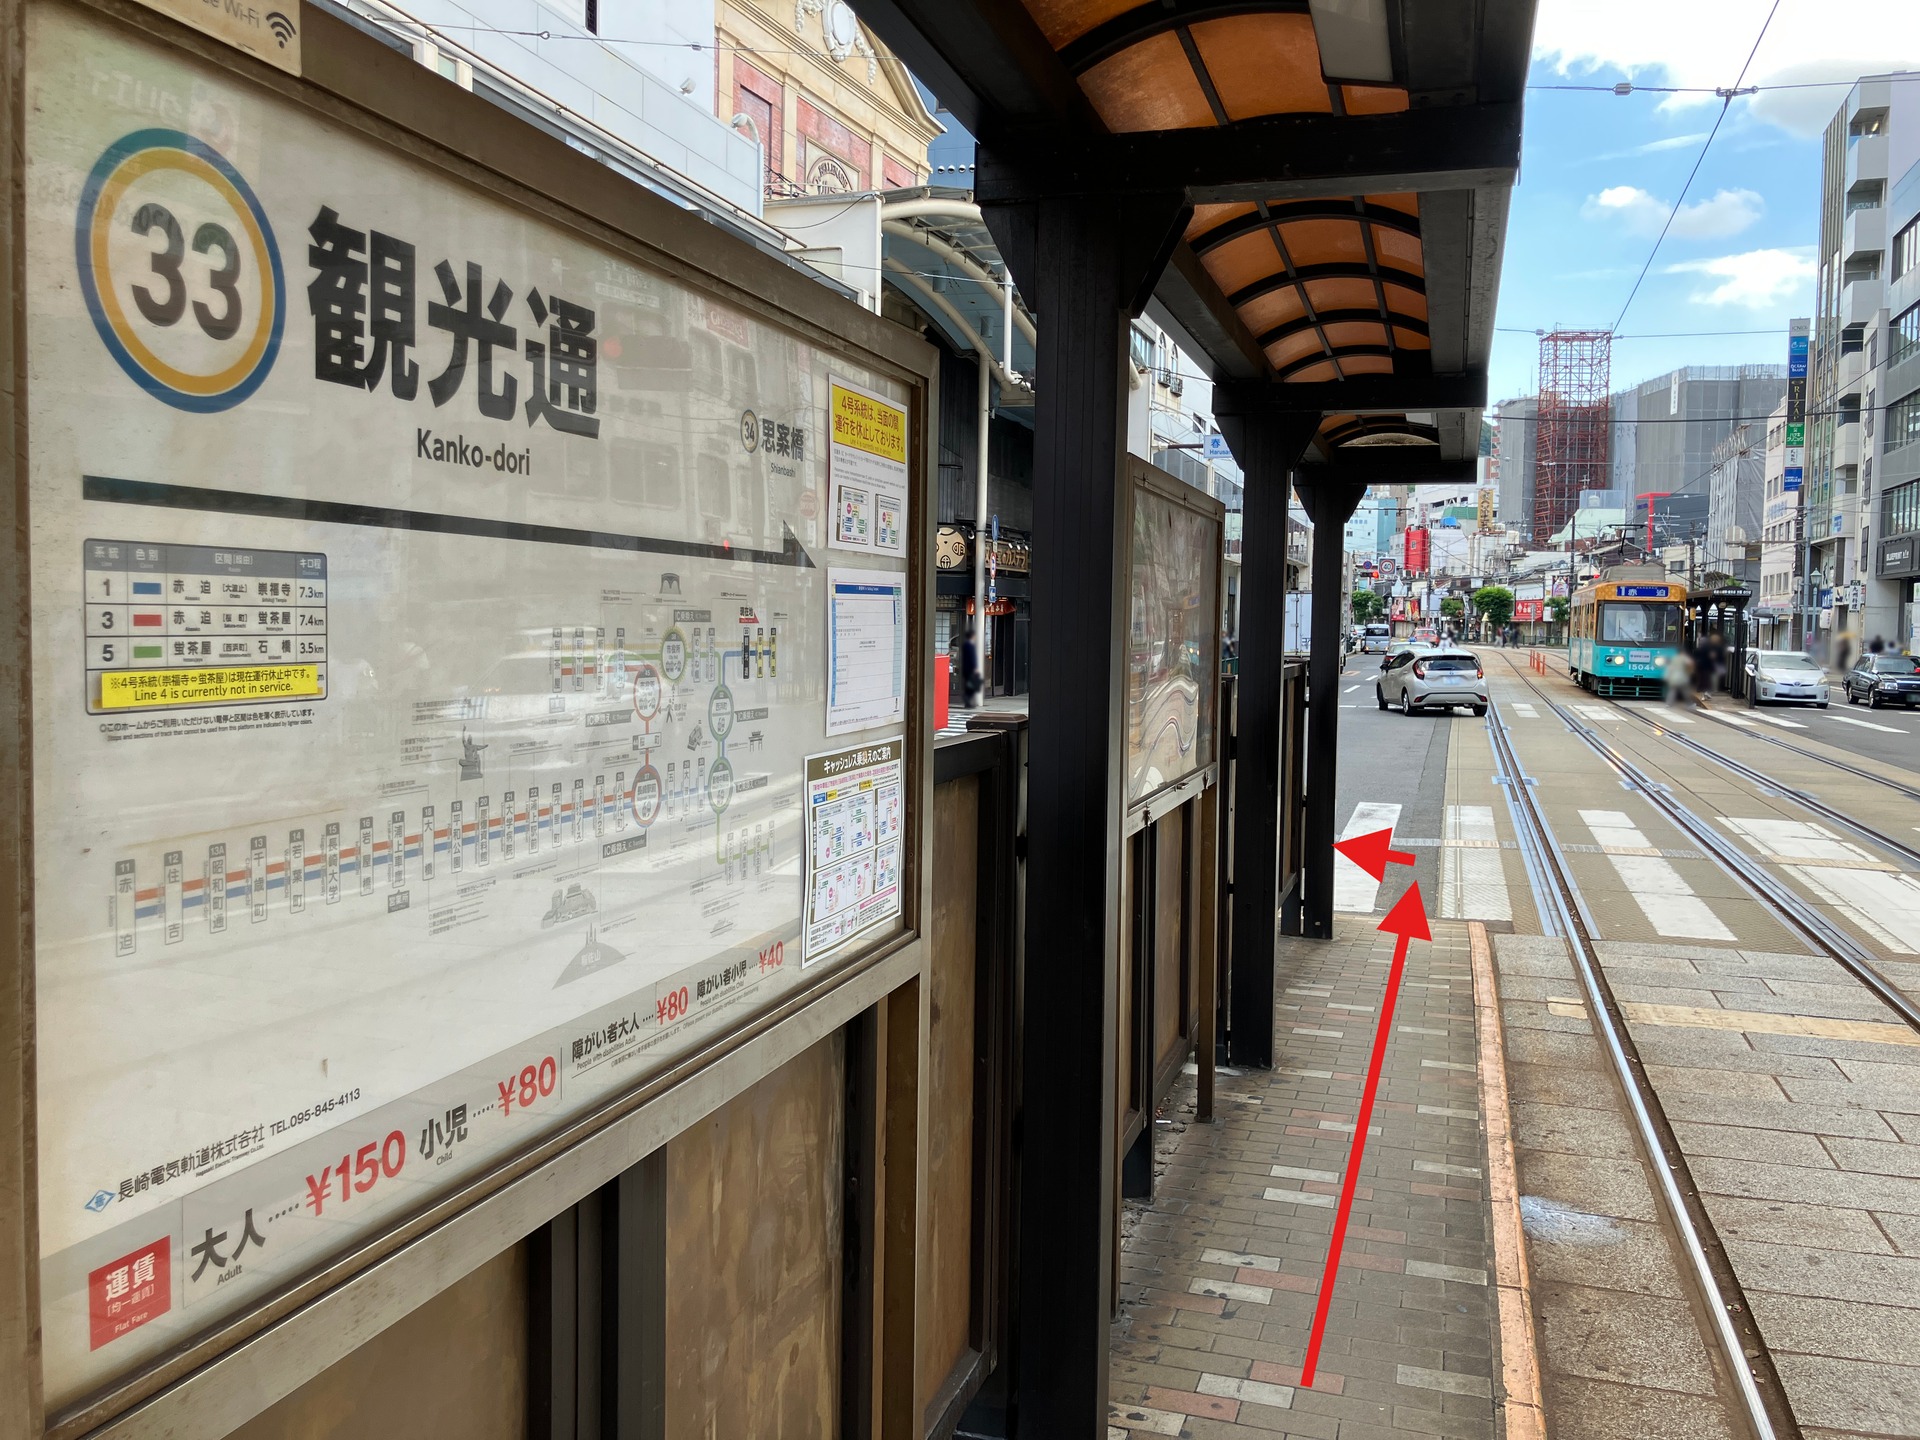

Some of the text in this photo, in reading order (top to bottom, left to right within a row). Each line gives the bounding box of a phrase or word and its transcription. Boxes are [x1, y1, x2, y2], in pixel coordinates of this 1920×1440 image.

[224, 0, 260, 28] Wi-Fi
[131, 202, 242, 341] 33
[307, 204, 601, 439] 観光通
[841, 395, 899, 432] 4号系統は、当面の間
[744, 420, 755, 443] 34
[761, 418, 804, 462] 思案橋
[834, 413, 904, 453] 運行を休止しております。
[416, 427, 531, 477] Kanko-dori
[770, 462, 796, 478] Shianbashi
[94, 546, 119, 559] 系統
[135, 548, 159, 561] 色別
[299, 558, 322, 570] キロ程
[1383, 562, 1391, 570] 40
[103, 578, 111, 596] 1
[258, 582, 291, 597] 崇福寺
[300, 586, 324, 599] 7.3km
[1620, 586, 1626, 596] 1
[101, 611, 114, 629] 3
[258, 611, 291, 625] 蛍茶屋
[300, 614, 324, 626] 7.4km
[101, 644, 114, 662] 5
[174, 641, 212, 655] 蛍茶屋
[300, 642, 324, 654] 3.5km
[134, 681, 294, 701] Line 4 is currently not in service.
[823, 745, 892, 774] キャッシュレス乗換えのご案内
[480, 798, 488, 806] 20
[530, 788, 537, 796] 22
[395, 813, 402, 821] 17
[424, 807, 433, 816] 18
[328, 825, 337, 834] 15
[362, 819, 371, 827] 16
[505, 803, 513, 856] 大学病院
[530, 799, 538, 850] 浦上駅前
[254, 839, 263, 847] 13
[293, 831, 302, 839] 14
[452, 813, 461, 869] 平和公園
[168, 853, 179, 864] 12
[210, 845, 224, 855] 13A
[424, 820, 433, 876] 大橋
[120, 863, 130, 873] 11
[328, 837, 338, 900] 長崎大学
[362, 830, 371, 891] 岩屋橋
[253, 851, 265, 917] 千歳町
[292, 844, 303, 908] 若葉町
[167, 868, 180, 939] 住吉
[212, 859, 224, 929] 昭和町通
[118, 877, 134, 951] 赤迫
[696, 940, 784, 1001] 障がい者小児 ¥40
[572, 986, 689, 1063] 障がい者大人 ¥80
[576, 1058, 592, 1070] People
[269, 1087, 361, 1137] TEL.095-845-4113
[419, 1055, 556, 1161] 小児 ¥80
[118, 1123, 265, 1203] 長崎電気軌道株式会社
[436, 1150, 453, 1166] Child
[191, 1129, 406, 1283] 大人 ¥150
[105, 1252, 155, 1302] 運賃
[217, 1264, 243, 1286] Adult
[114, 1312, 148, 1334] Flat Fare
